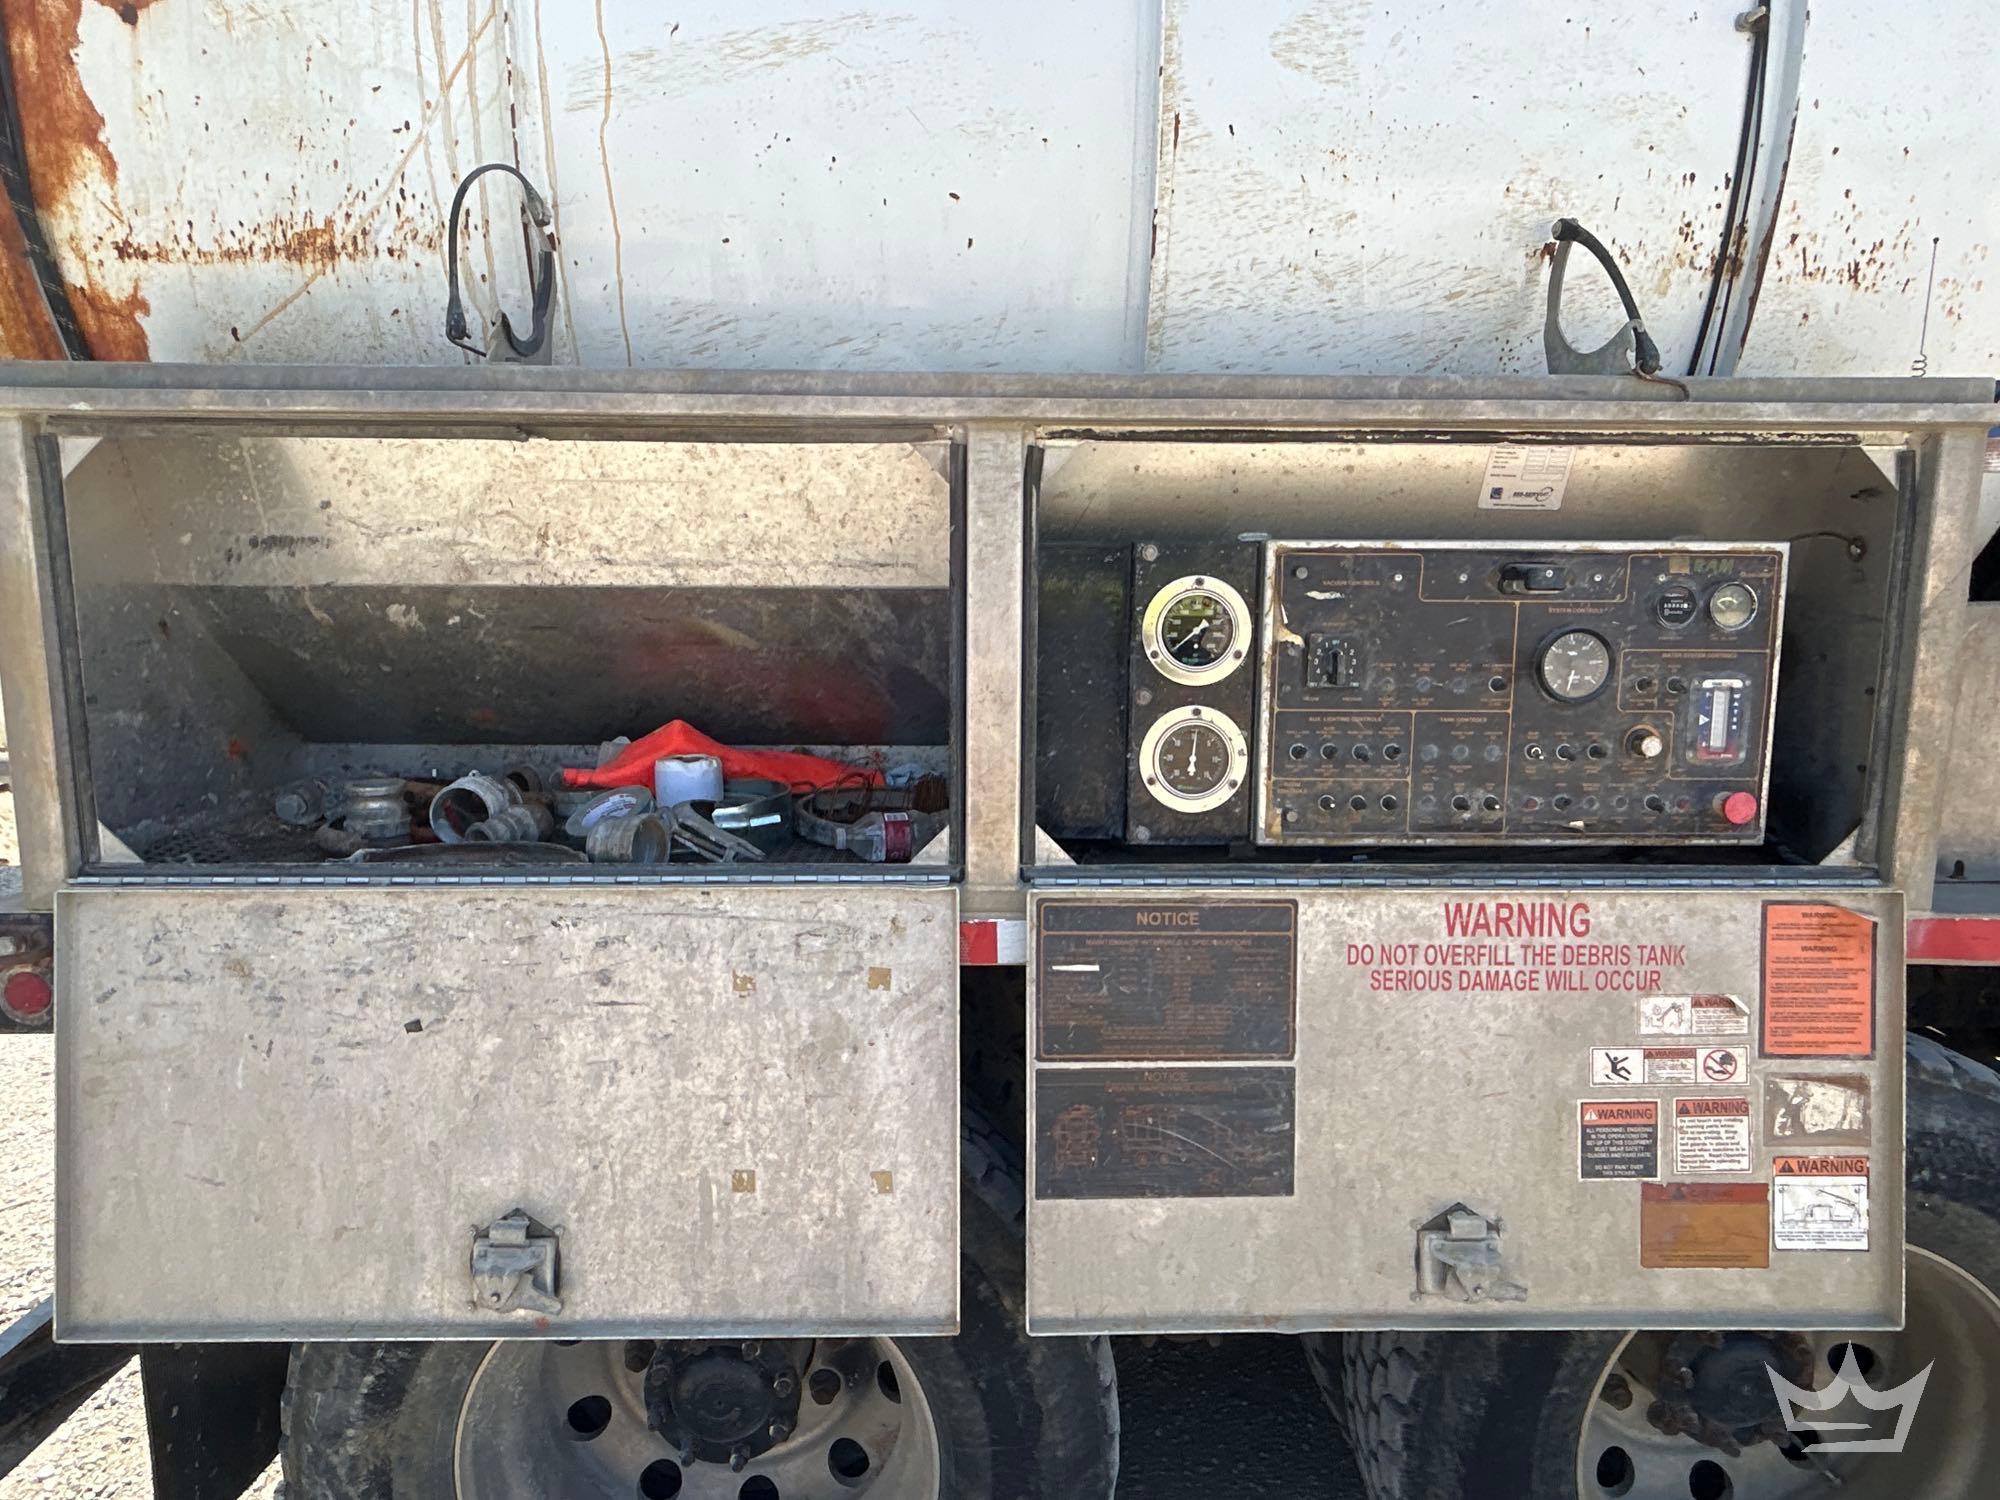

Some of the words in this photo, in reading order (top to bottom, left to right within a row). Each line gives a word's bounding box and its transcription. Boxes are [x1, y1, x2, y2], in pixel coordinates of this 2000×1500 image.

[1136, 911, 1200, 926] NOTICE
[1445, 902, 1592, 938] WARNING
[1346, 944, 1374, 966] DO
[1380, 944, 1419, 966] NOT
[1424, 944, 1515, 966] OVERFILL
[1520, 944, 1556, 966] THE
[1563, 944, 1631, 966] DEBRIS
[1636, 944, 1686, 966] TANK
[1370, 970, 1452, 991] SERIOUS
[1458, 970, 1539, 991] DAMAGE
[1545, 970, 1589, 991] WILL
[1595, 970, 1661, 991] OCCUR
[1144, 1071, 1188, 1082] NOTICE
[1597, 1108, 1653, 1120] WARNING
[1692, 1102, 1748, 1114] WARNING
[1797, 1159, 1864, 1173] WARNING
